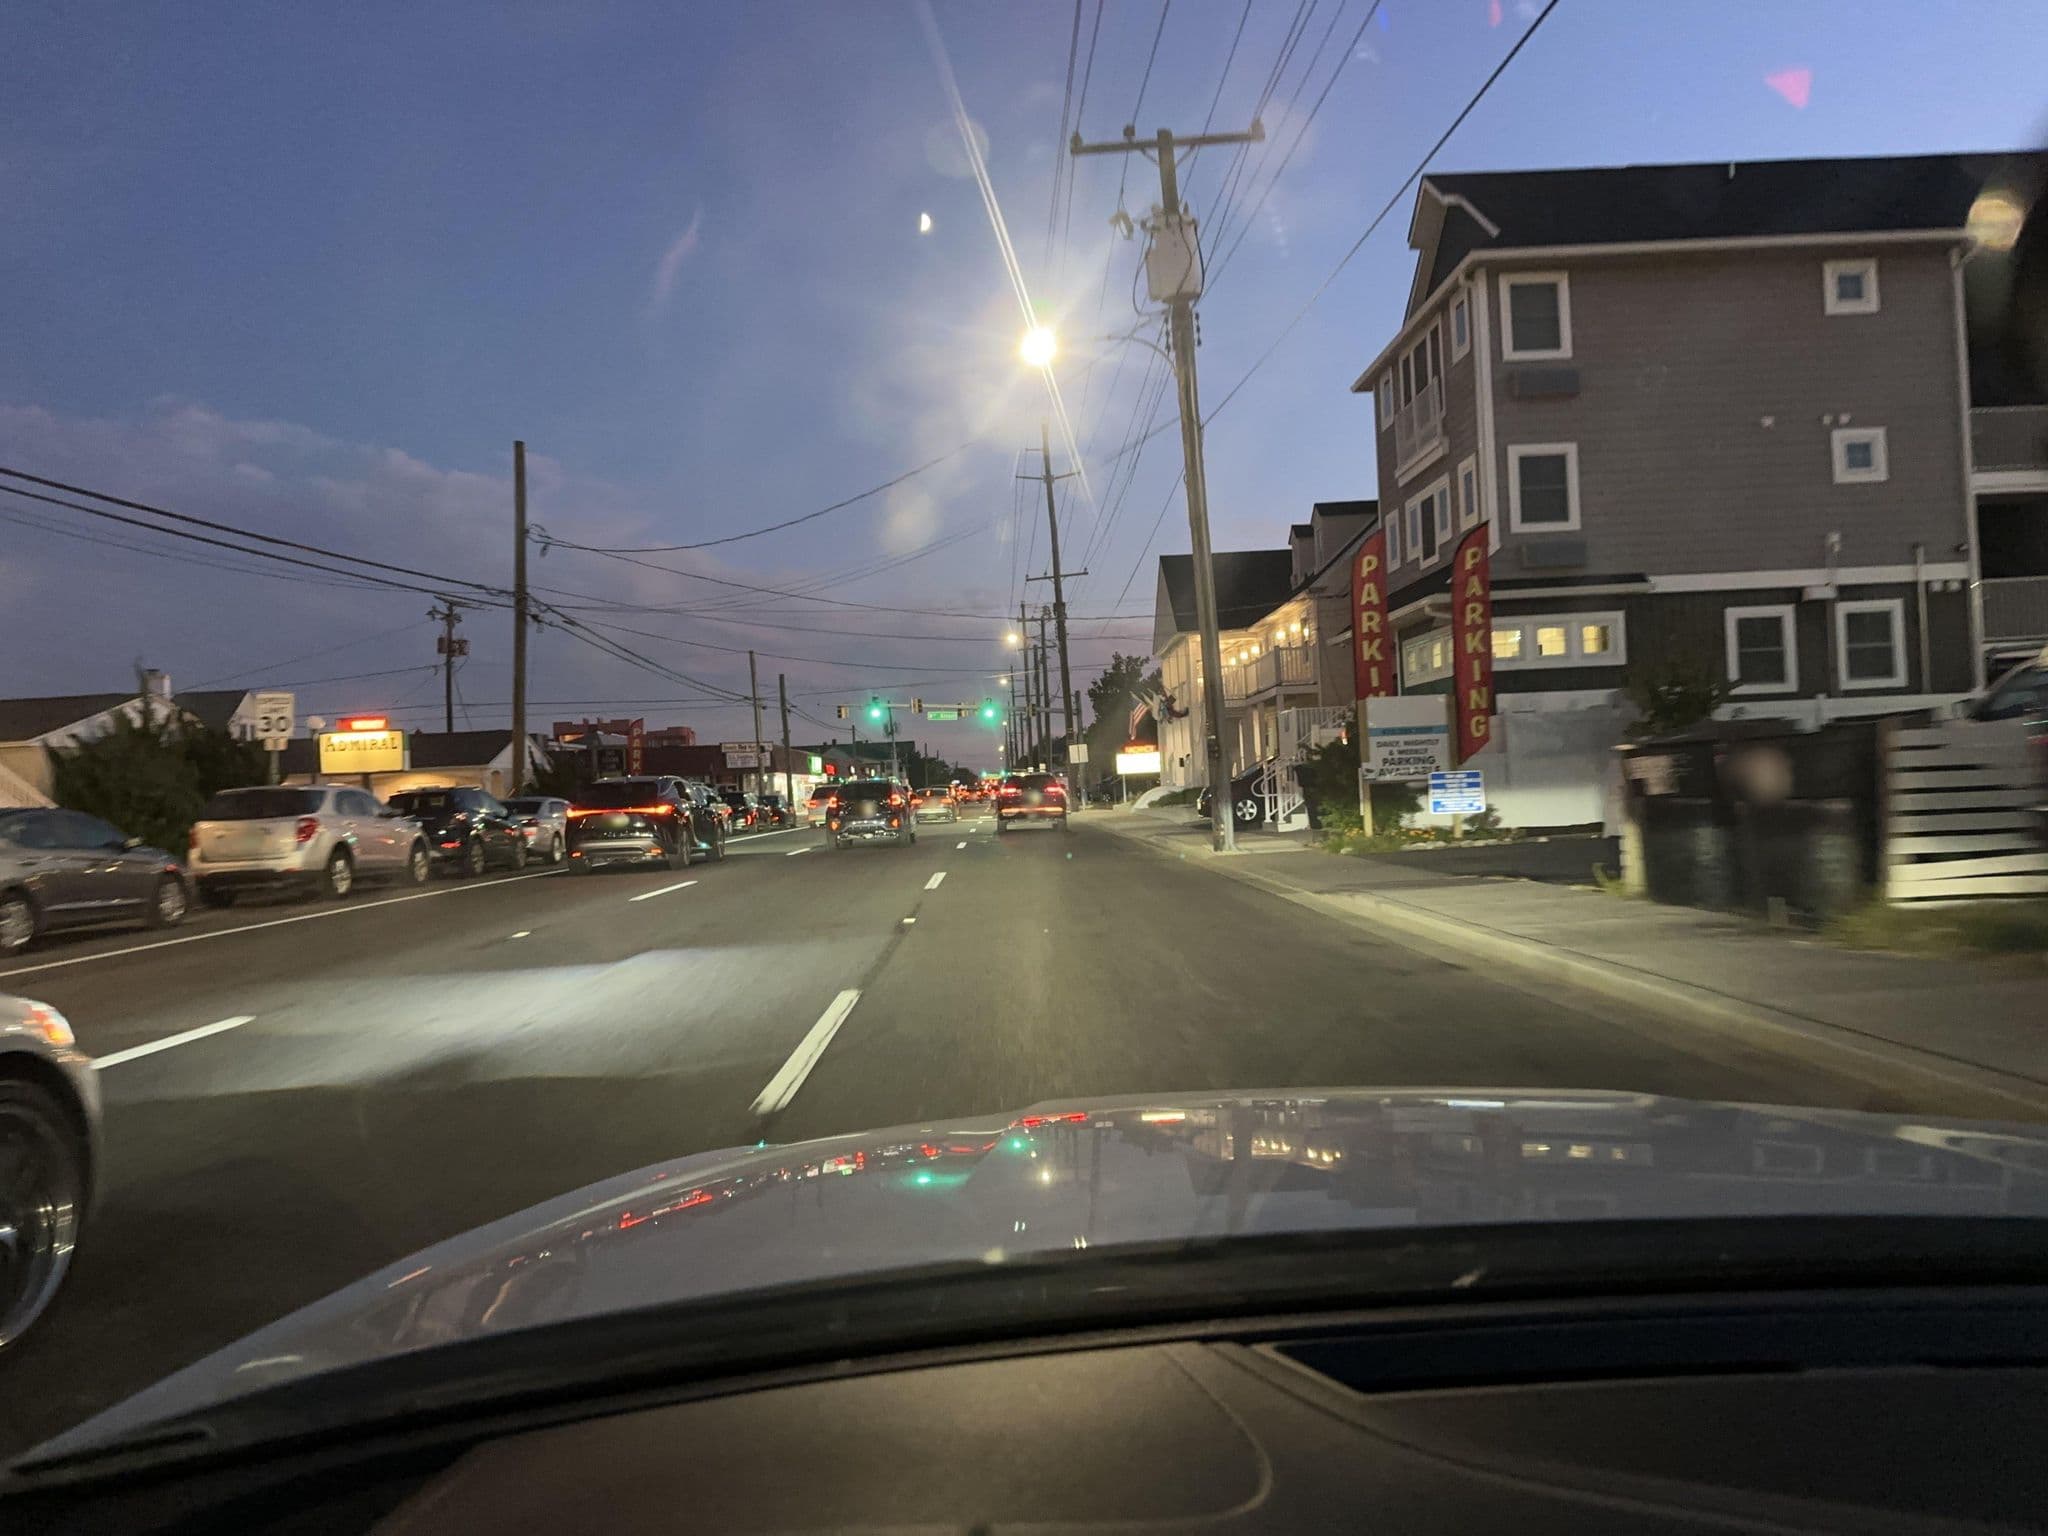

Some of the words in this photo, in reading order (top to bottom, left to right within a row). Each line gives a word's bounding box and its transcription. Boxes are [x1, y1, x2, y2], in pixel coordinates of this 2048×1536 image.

[1360, 555, 1387, 697] PARKI
[1464, 547, 1489, 738] PARKING
[258, 715, 291, 732] 30
[324, 735, 399, 753] ADMIRAL
[1381, 755, 1437, 767] PARKING
